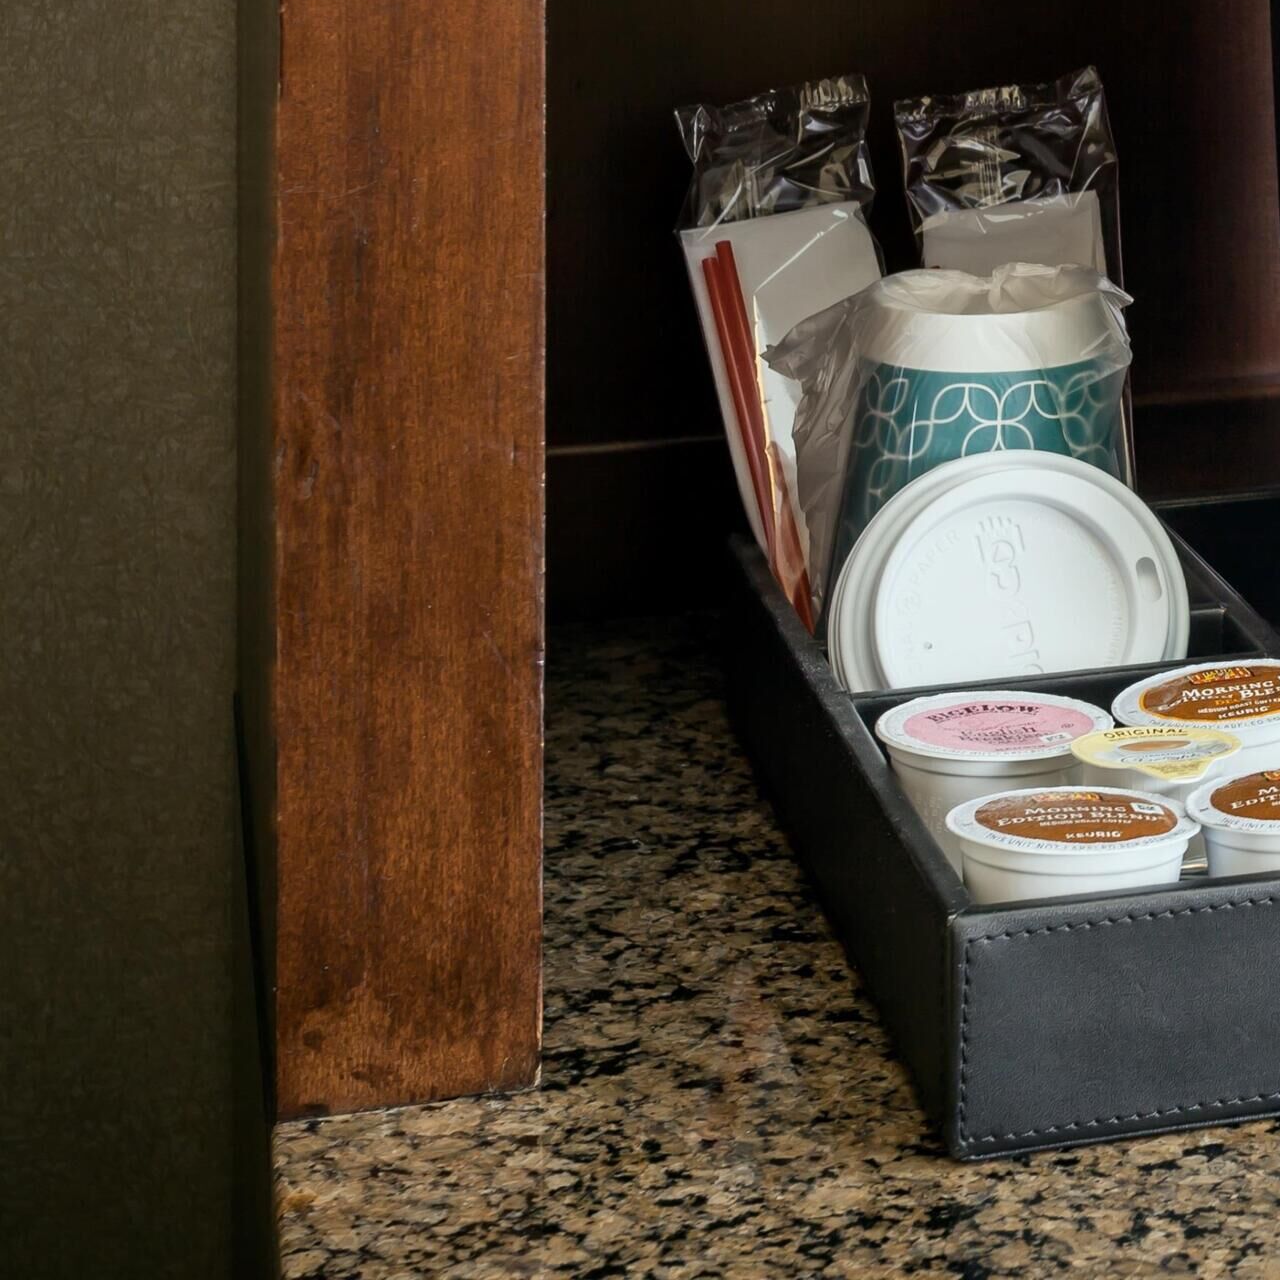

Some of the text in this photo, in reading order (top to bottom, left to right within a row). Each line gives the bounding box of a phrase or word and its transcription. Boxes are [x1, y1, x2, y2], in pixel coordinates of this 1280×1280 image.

[1181, 680, 1274, 697] MORNING
[926, 703, 1042, 723] BIGELOW
[1218, 705, 1269, 719] KEURIG
[1103, 728, 1188, 739] ORIGINAL
[1024, 806, 1127, 816] MORNING
[997, 811, 1158, 827] EDITION BLEND
[1065, 830, 1121, 839] KEURIG
